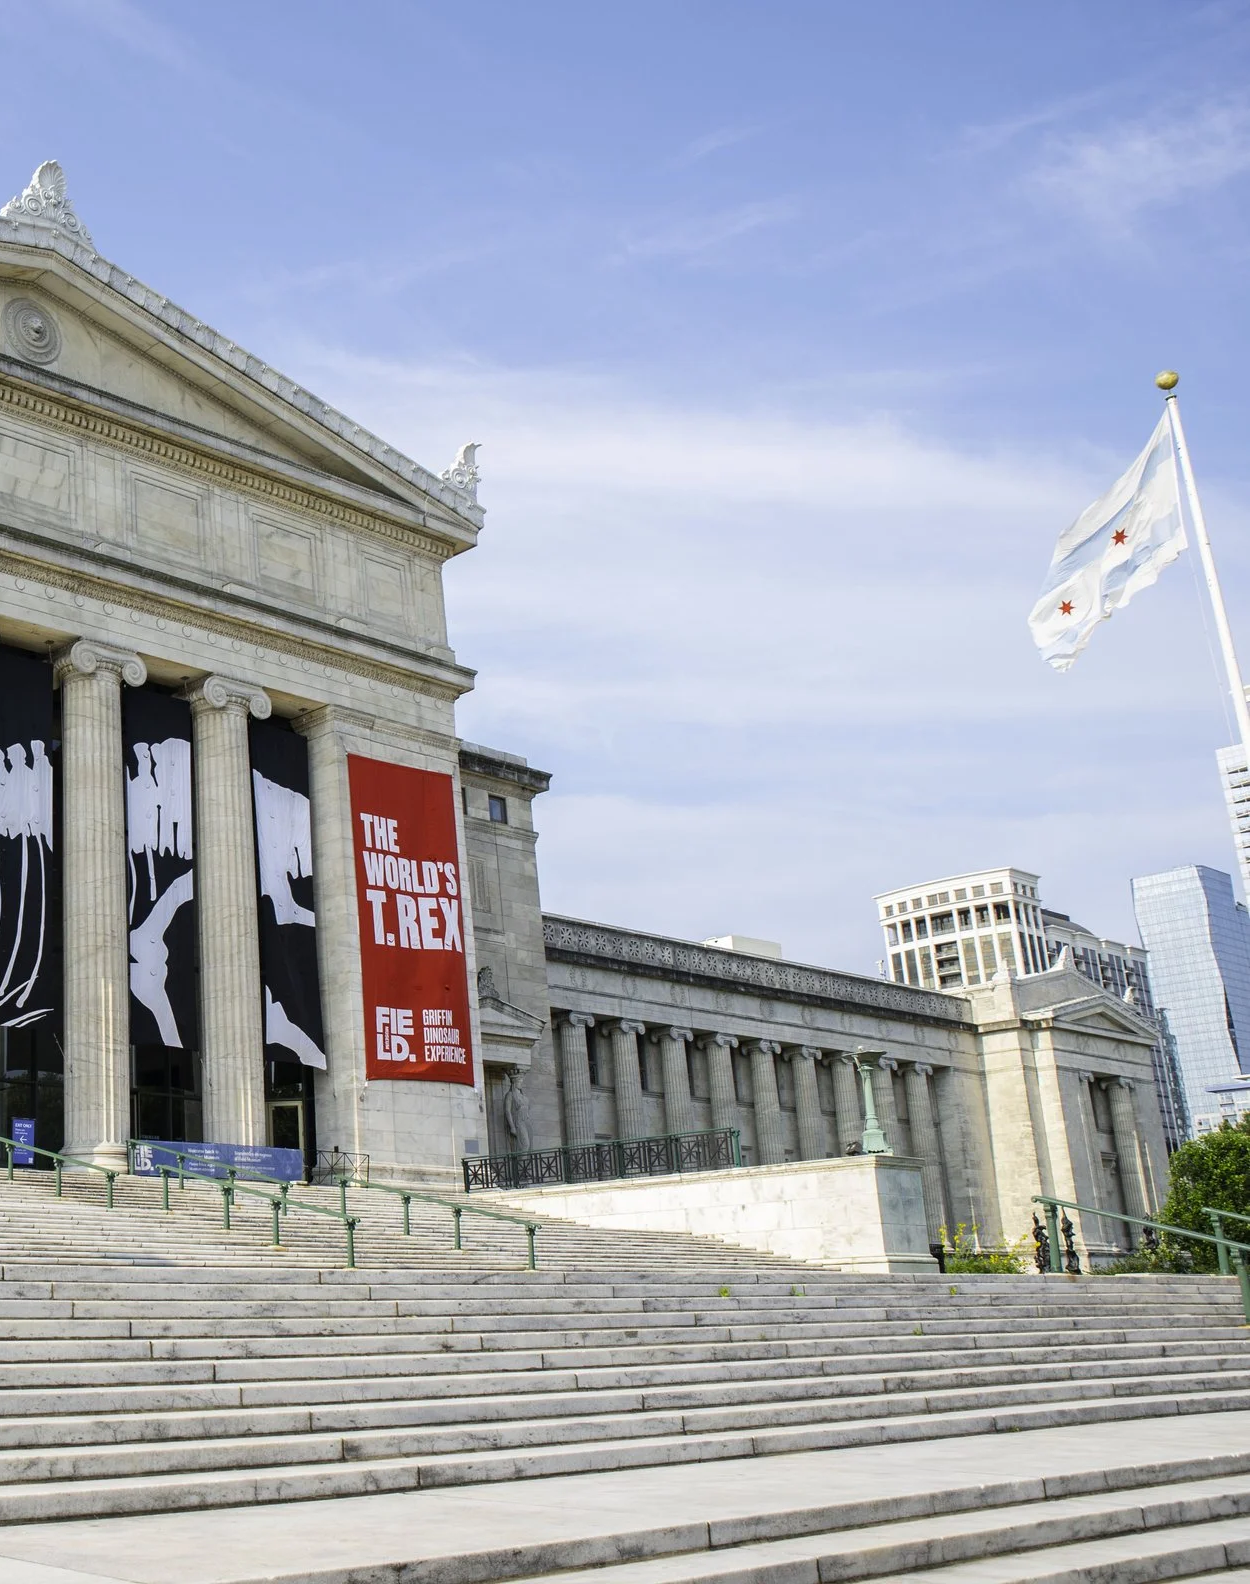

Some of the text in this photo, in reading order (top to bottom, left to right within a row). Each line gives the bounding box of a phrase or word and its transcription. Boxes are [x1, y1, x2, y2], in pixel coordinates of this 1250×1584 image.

[360, 813, 400, 853] THE
[363, 851, 458, 896] WORLD'S
[422, 1009, 452, 1026] GRIFFIN
[423, 1027, 460, 1045] DINOSAUR
[424, 1045, 466, 1065] EXPERIENCE
